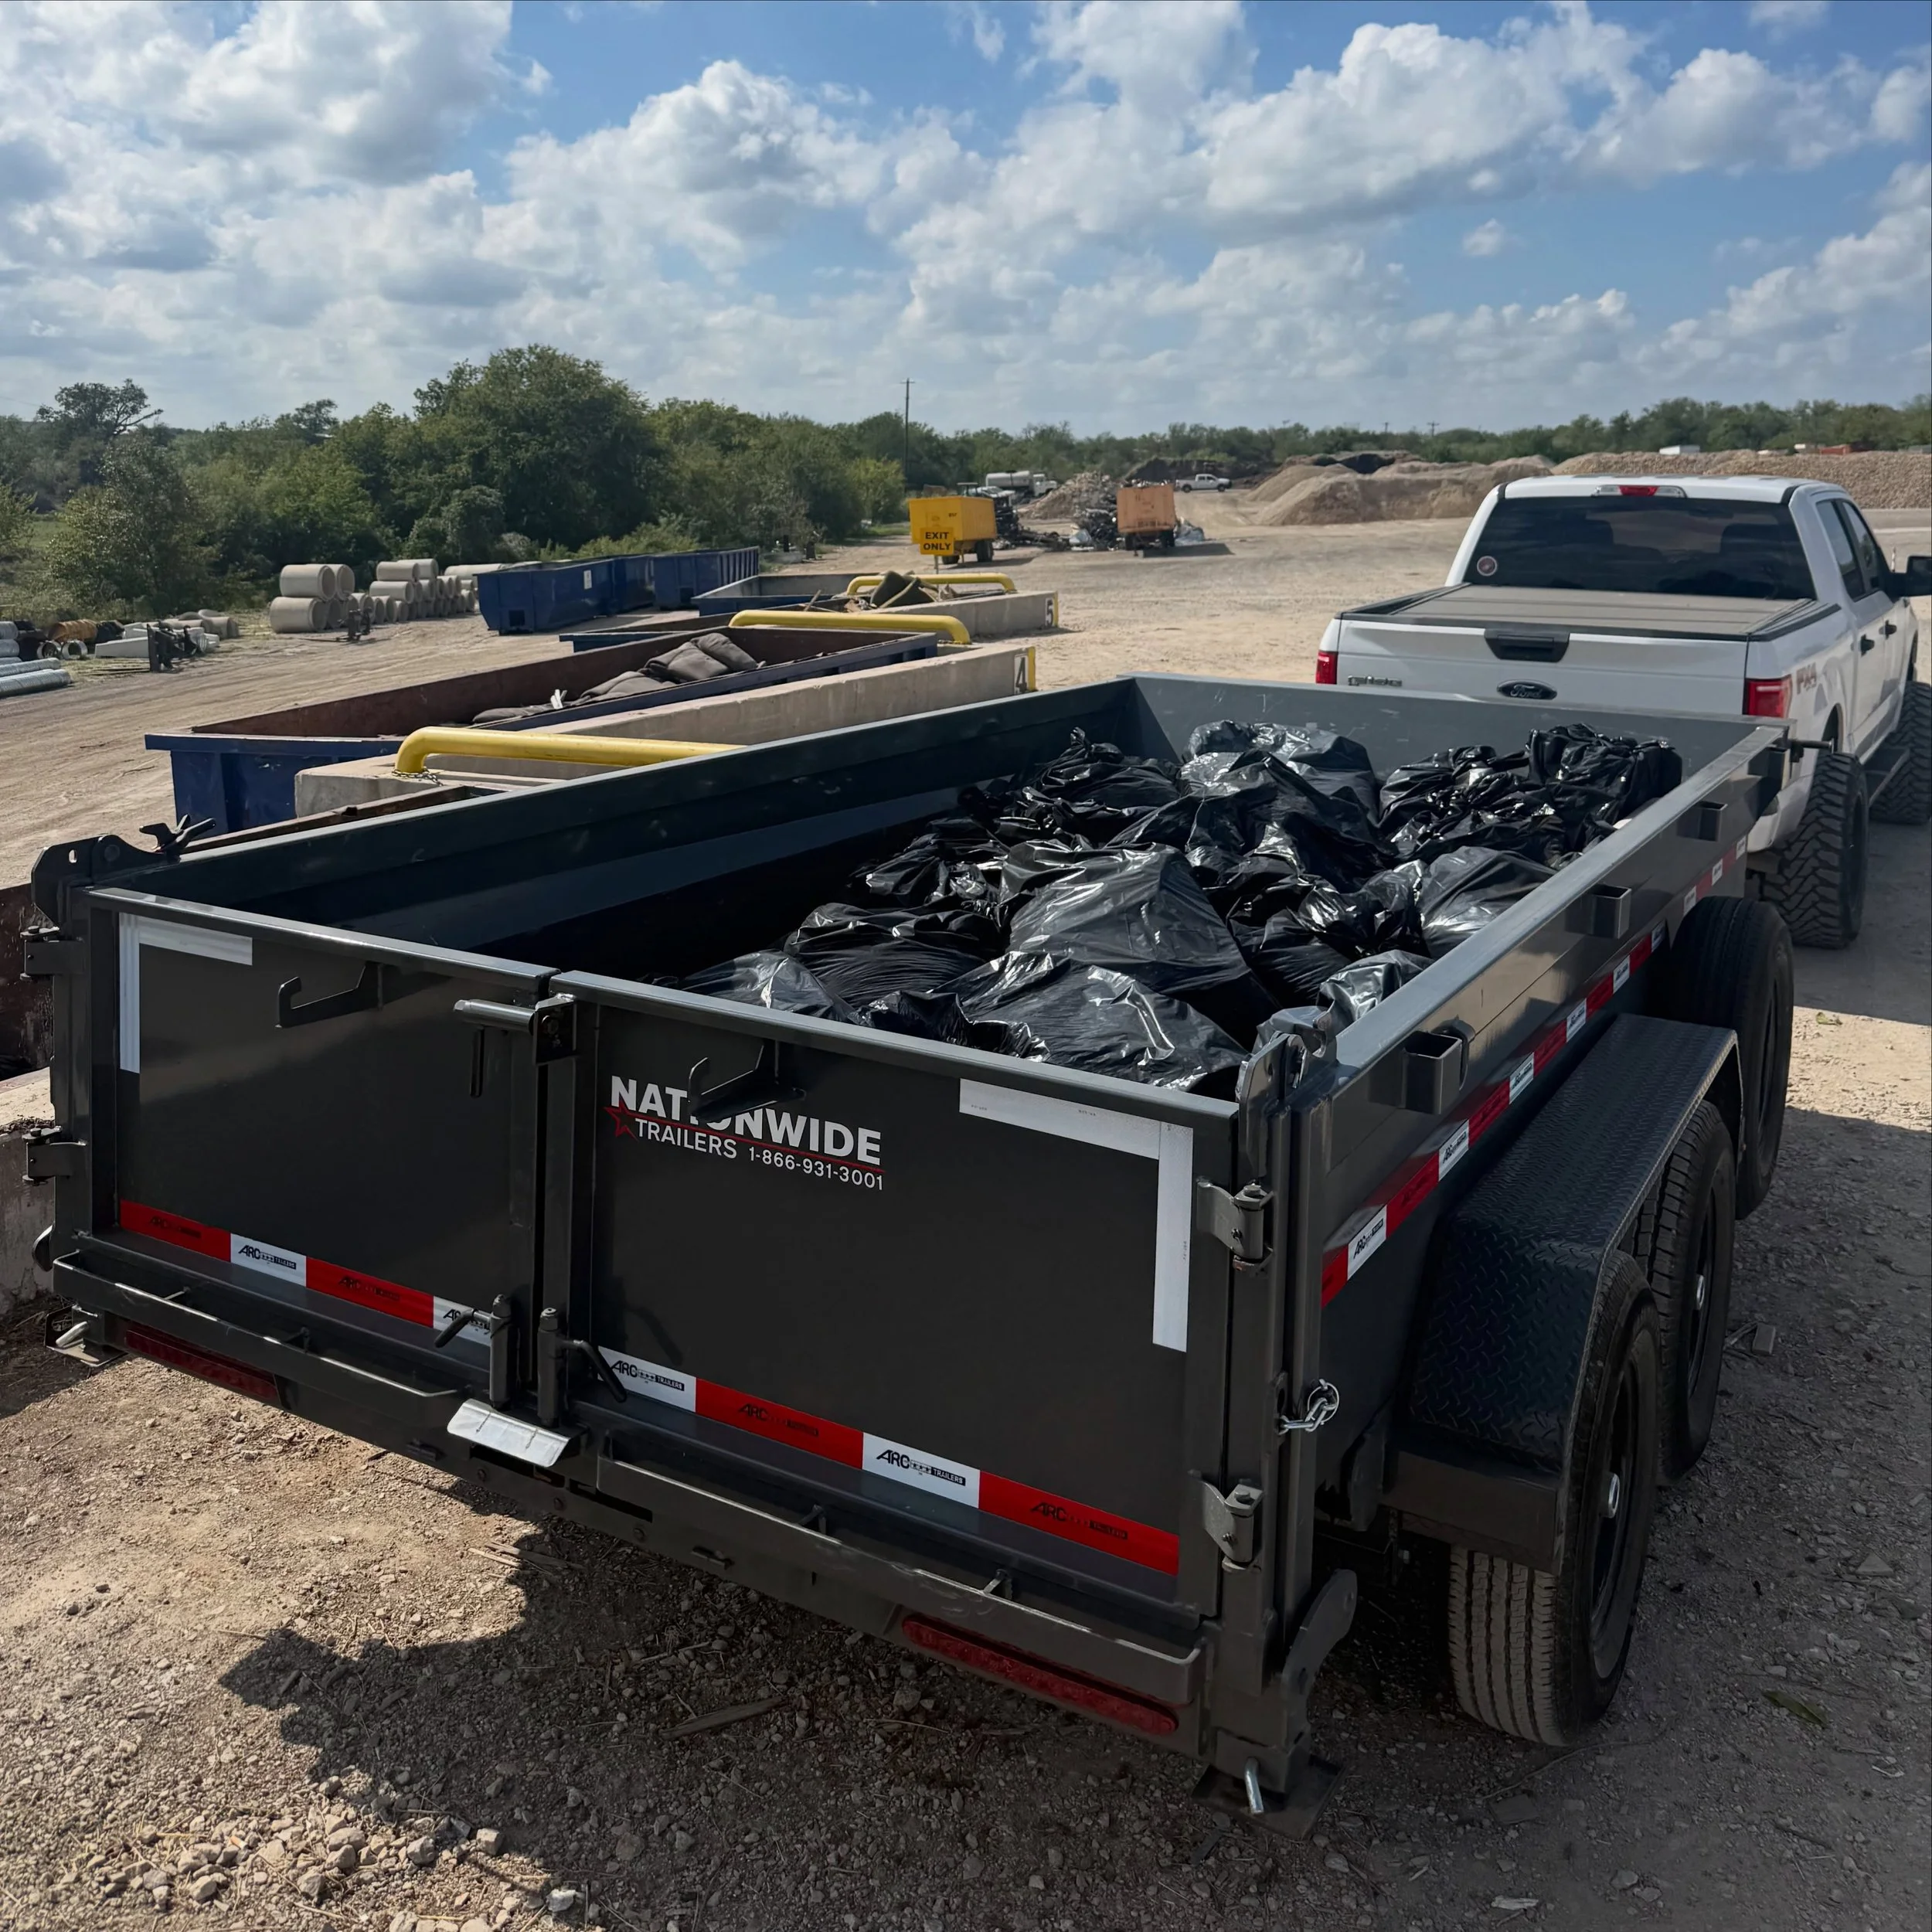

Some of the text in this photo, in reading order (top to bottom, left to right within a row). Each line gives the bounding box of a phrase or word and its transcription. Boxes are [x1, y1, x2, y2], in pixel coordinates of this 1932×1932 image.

[923, 543, 951, 551] ONLY
[1046, 599, 1054, 627] 5
[1015, 657, 1028, 694] 4
[611, 1075, 882, 1165] NATNWIDE
[634, 1117, 883, 1191] TRAILERS 1-866-931-3001
[238, 1244, 261, 1260] ARC
[611, 1360, 683, 1391] ARC TRAILERS
[876, 1450, 964, 1485] ARC TRAILERS
